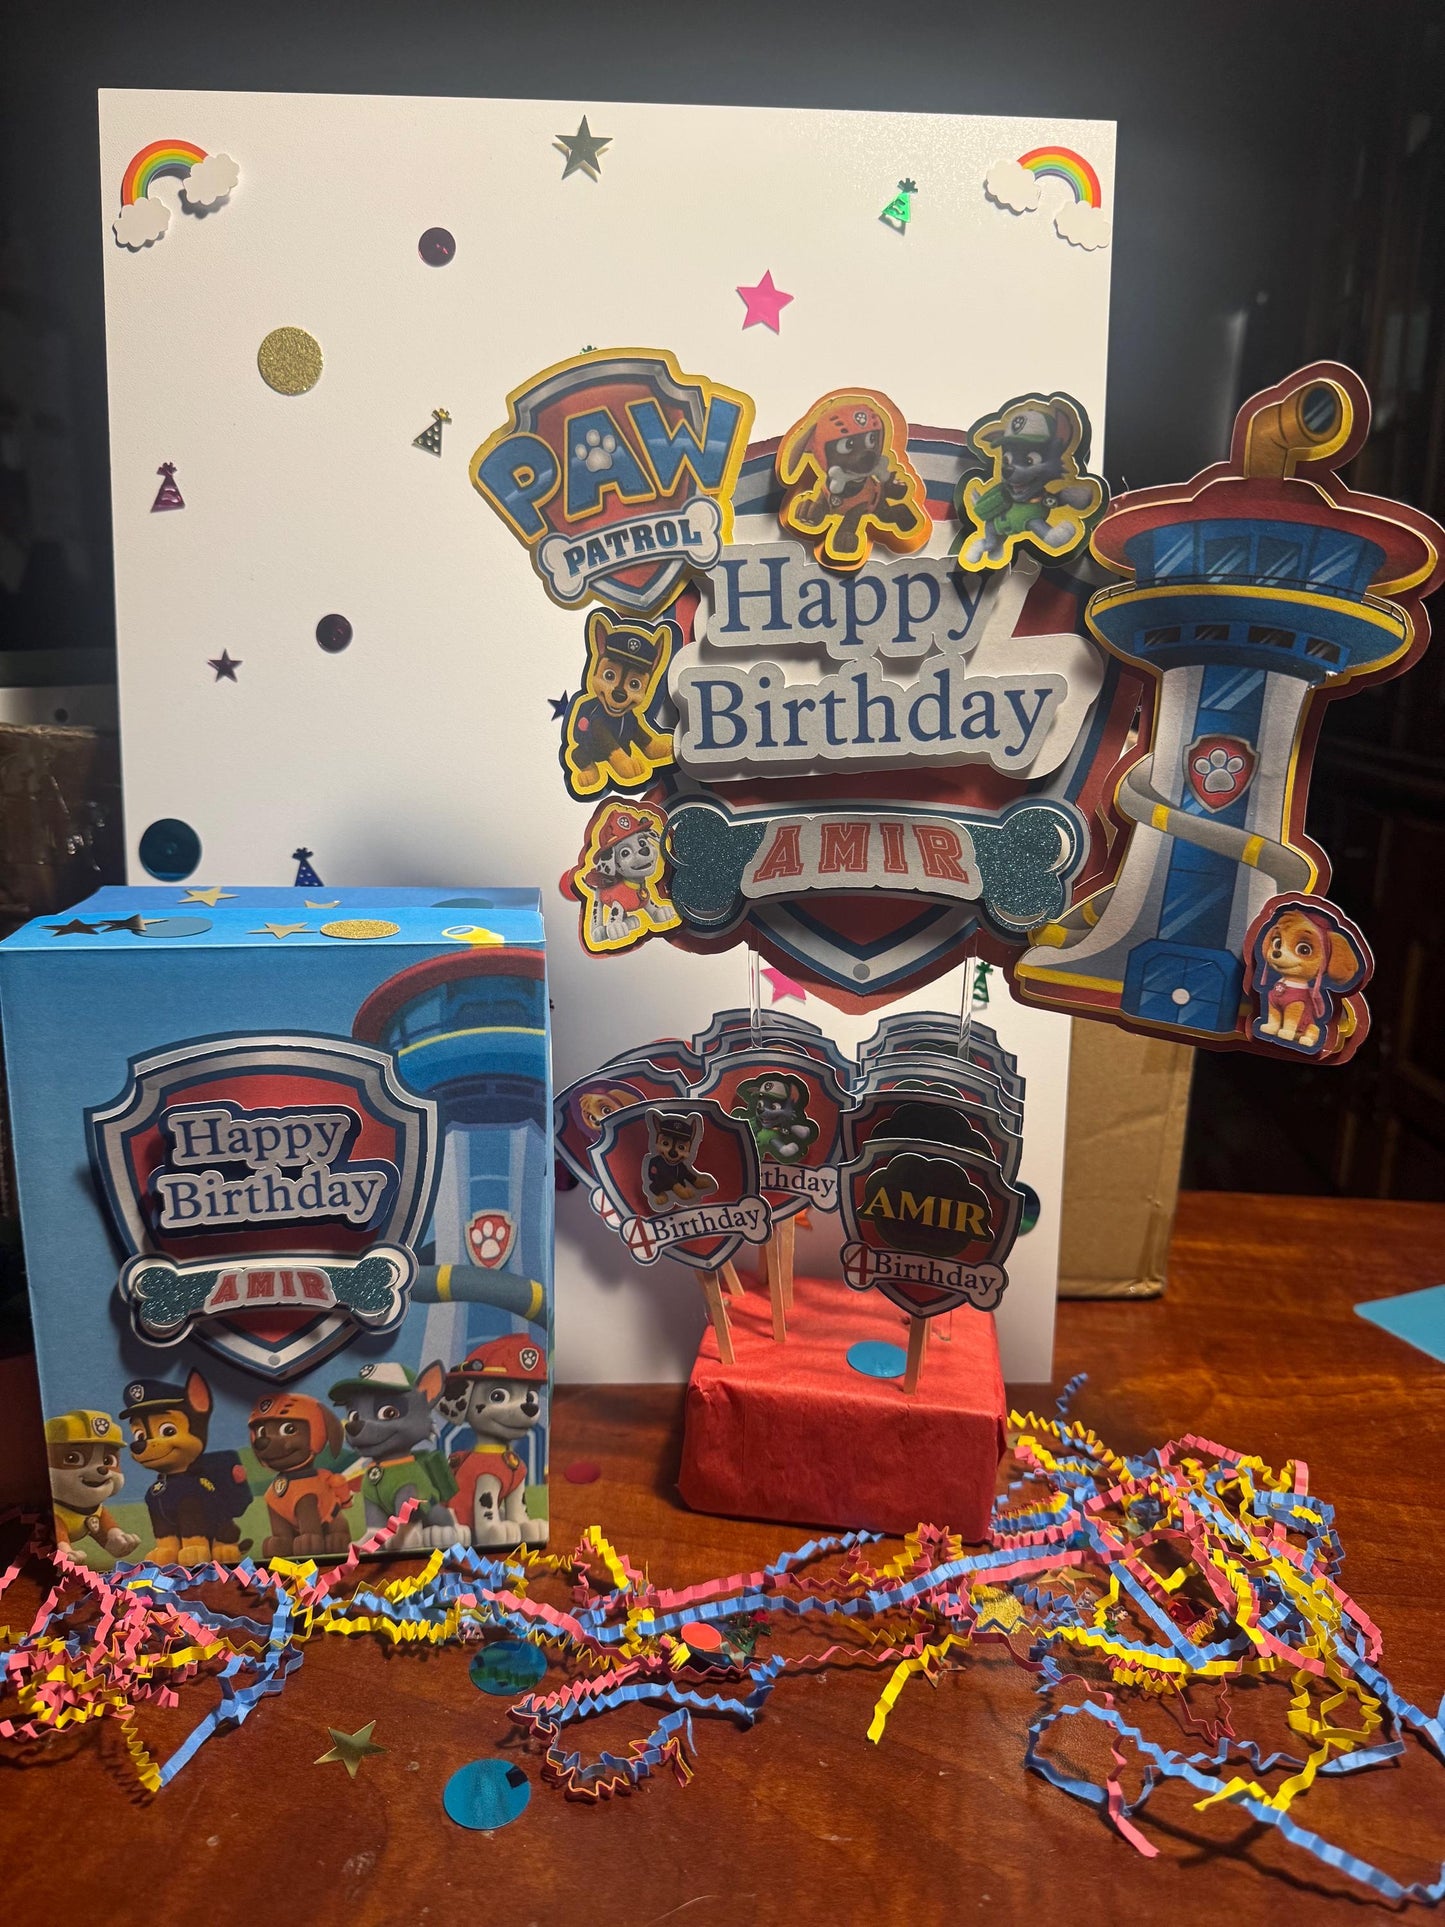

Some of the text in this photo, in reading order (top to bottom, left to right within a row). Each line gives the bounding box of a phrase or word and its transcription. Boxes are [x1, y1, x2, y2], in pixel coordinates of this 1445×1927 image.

[477, 396, 744, 545] PAW
[562, 518, 703, 577] PATROL
[718, 556, 997, 646] Happy
[691, 667, 1054, 757] Birthday
[753, 822, 970, 884] AMIR
[177, 1116, 343, 1162] Happy
[164, 1171, 381, 1222] Birthday
[760, 1166, 836, 1198] thday
[627, 1206, 760, 1259] 4 Birthday
[864, 1186, 987, 1237] AMIR
[210, 1270, 329, 1306] AMIR
[844, 1244, 998, 1296] 4 Birthday
